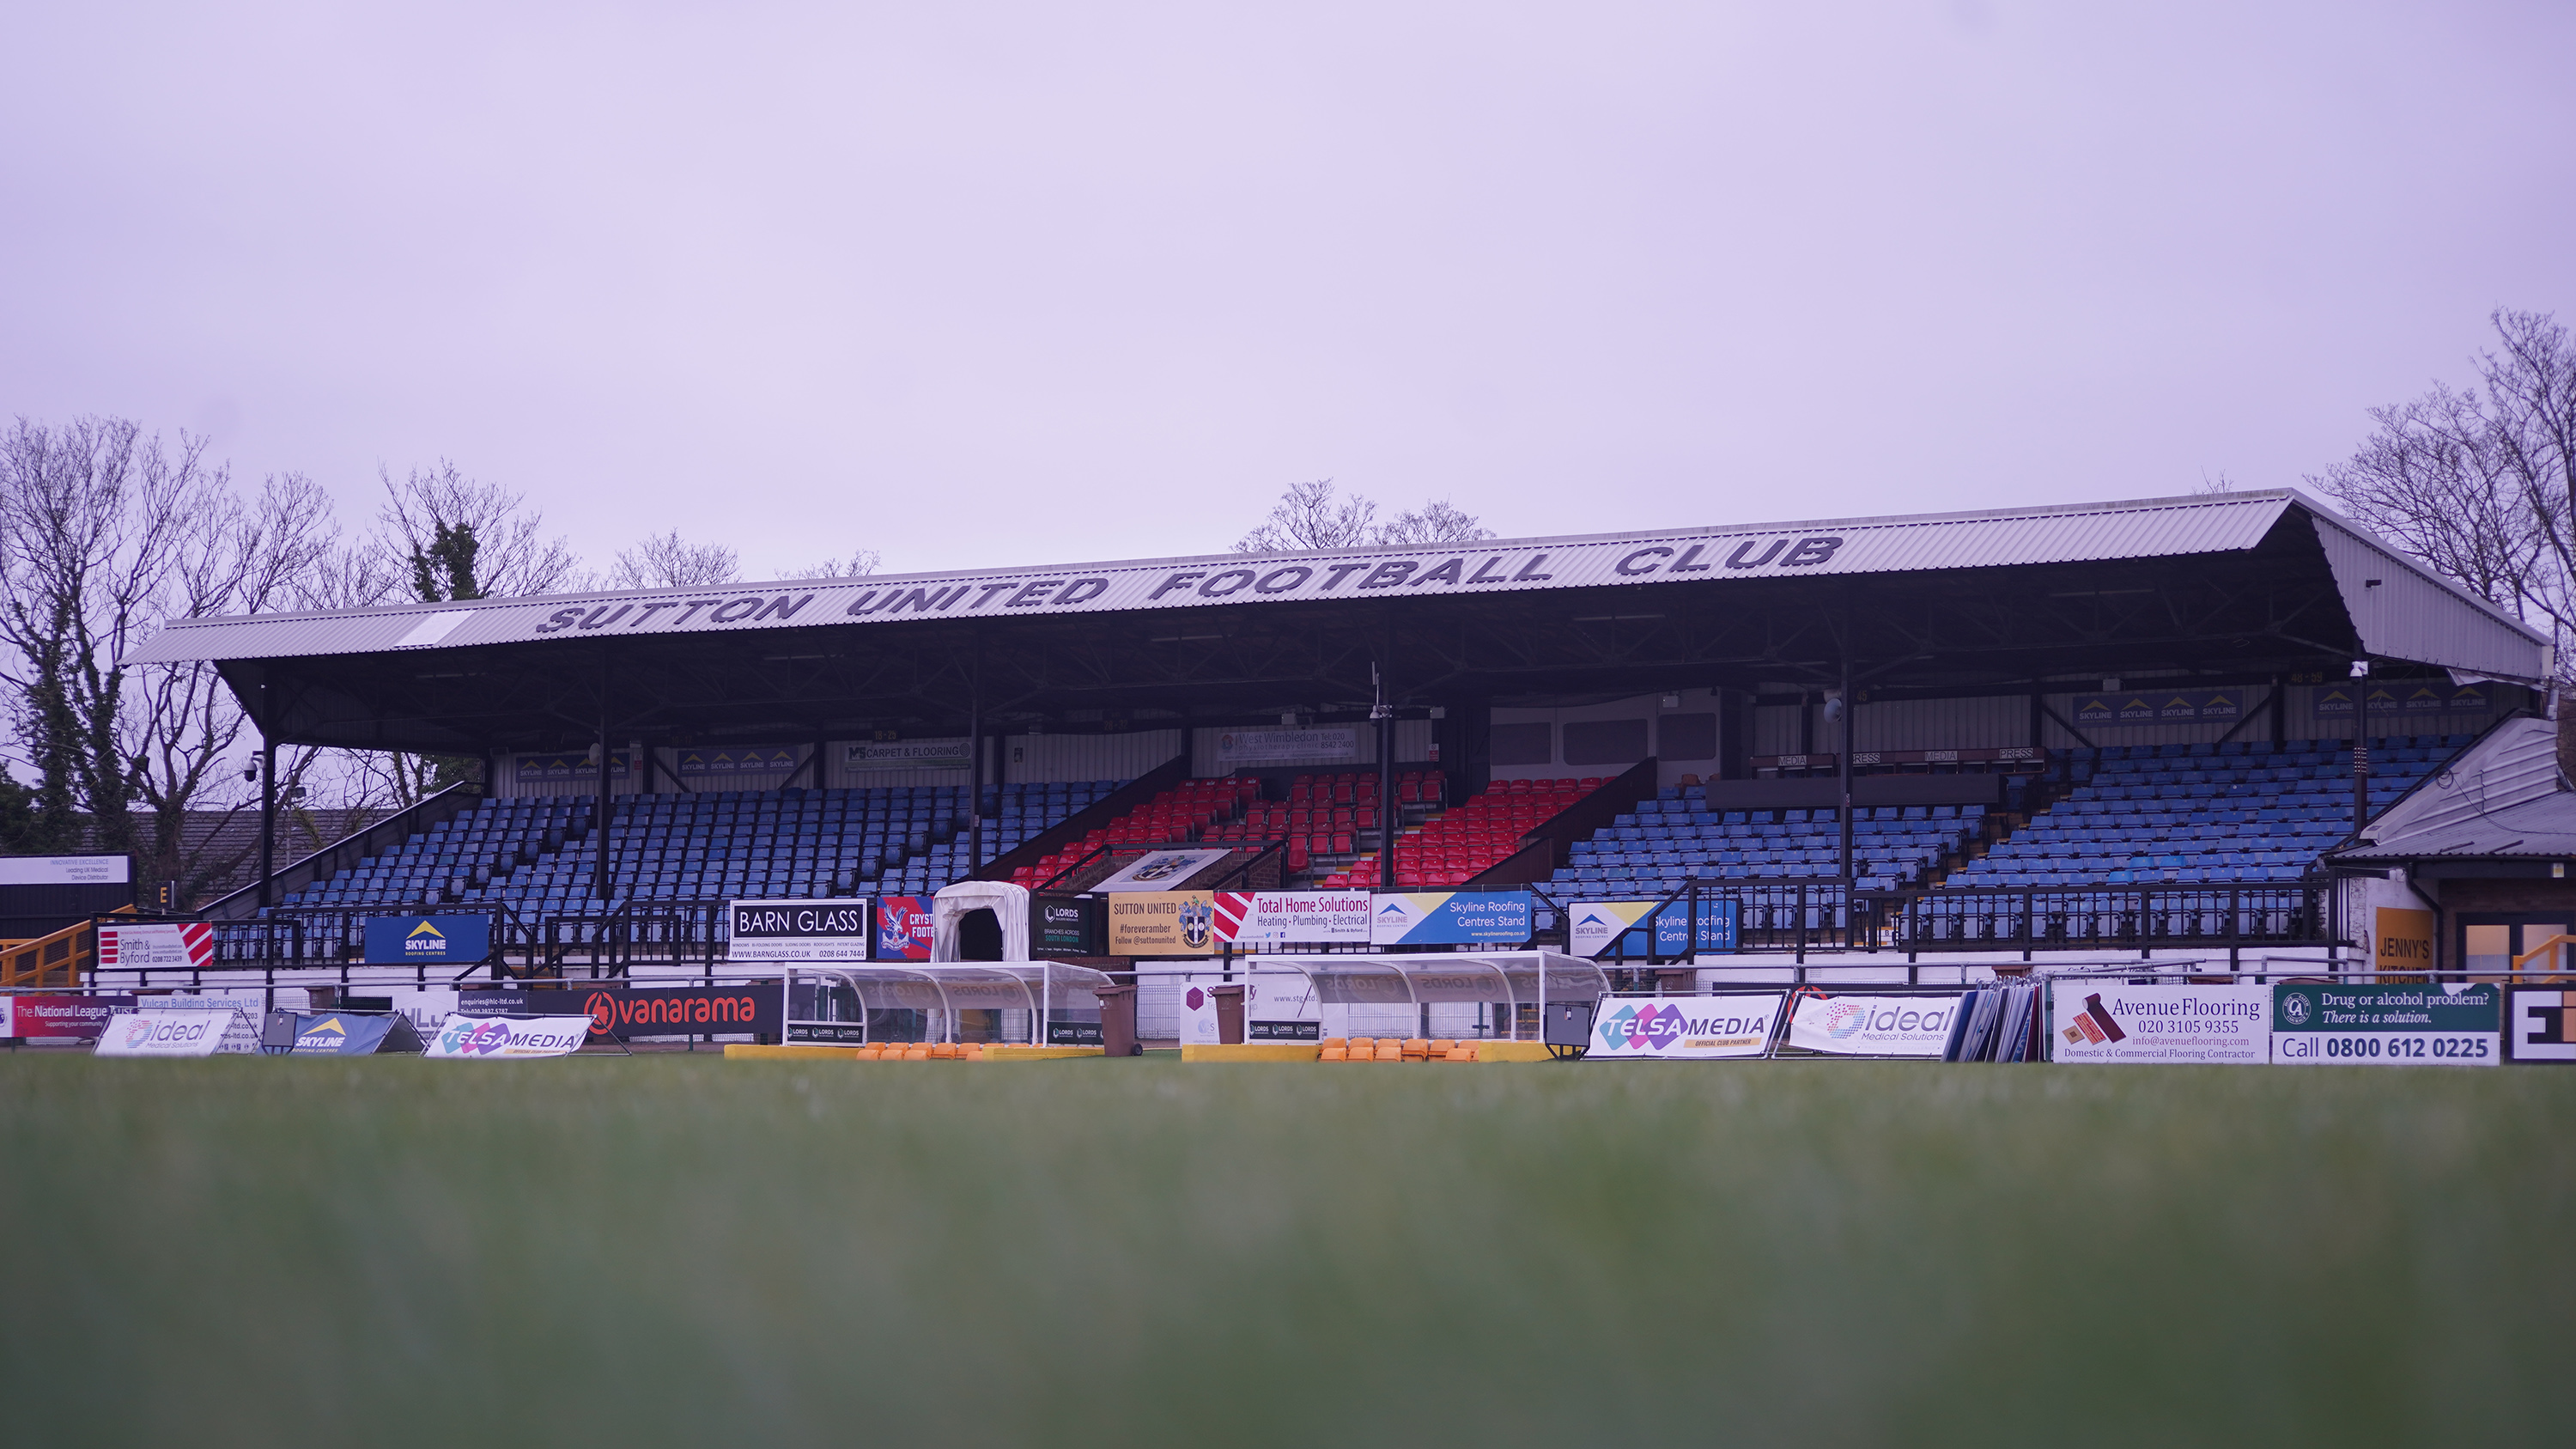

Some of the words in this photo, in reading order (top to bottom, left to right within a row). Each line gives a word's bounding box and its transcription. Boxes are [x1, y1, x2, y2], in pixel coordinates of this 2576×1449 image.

[535, 594, 814, 632] SUTTON
[846, 577, 1109, 616] UNITED
[1147, 554, 1570, 601] FOOTBALL
[1614, 535, 1844, 575] CLUB
[2161, 709, 2195, 717] SKYLINE
[2202, 707, 2237, 715] SKYLINE
[2319, 703, 2354, 711] SKYLINE
[2079, 711, 2112, 720] SKYLINE
[874, 731, 883, 740] 18
[1238, 734, 1262, 744] West
[1264, 732, 1318, 743] Wimbledon
[866, 748, 902, 758] CARPET
[903, 748, 910, 757] &
[913, 746, 959, 757] FLOORING
[1238, 743, 1295, 752] physiotherapy
[2000, 748, 2033, 758] PRESS
[1778, 756, 1807, 765] MEDIA
[1853, 753, 1880, 763] RESS
[1925, 752, 1957, 761] MEDIA
[160, 887, 167, 903] E
[1114, 904, 1145, 916] SUTTON
[1146, 903, 1176, 915] UNITED
[1257, 898, 1283, 914] Total
[1285, 897, 1316, 914] Home
[1318, 896, 1368, 913] Solutions
[1449, 902, 1485, 914] Skyline
[1487, 901, 1526, 914] Roofing
[1055, 908, 1078, 917] LORDS
[739, 911, 790, 933] BARN
[797, 910, 858, 932] GLASS
[910, 914, 933, 925] CRYST
[1257, 916, 1287, 928] Heating
[1292, 915, 1327, 928] Plumbing
[1333, 914, 1367, 925] Electrical
[1376, 916, 1408, 924] SKYLINE
[1457, 916, 1493, 927] Centres
[1495, 916, 1525, 927] Stand
[1120, 923, 1171, 935] #foreveramber
[1700, 929, 1730, 941] Stand
[120, 938, 143, 951] Smith
[144, 940, 150, 950] &
[405, 940, 447, 950] SKYLINE
[1115, 935, 1132, 945] Follow
[1133, 935, 1176, 946] @suttonunited
[2380, 937, 2429, 959] JENNY'S
[120, 951, 150, 966] Byford
[141, 998, 168, 1008] Vulcan
[171, 998, 204, 1008] Building
[206, 997, 242, 1008] Services
[244, 997, 258, 1008] Ltd
[460, 997, 524, 1007] enquiries@hlc-ltd.co.uk
[2322, 992, 2355, 1009] Drug
[2359, 995, 2374, 1006] or
[2376, 992, 2423, 1006] alcohol
[2427, 993, 2490, 1010] problem?
[15, 1006, 33, 1018] The
[34, 1004, 73, 1018] National
[75, 1004, 107, 1020] League
[618, 996, 756, 1025] vanarama
[2112, 998, 2179, 1016] Avenue
[2182, 998, 2261, 1021] Flooring
[1865, 1005, 1954, 1032] ideal
[2323, 1011, 2357, 1023] There
[2360, 1011, 2369, 1023] is
[2371, 1014, 2380, 1023] a
[2382, 1011, 2432, 1024] solution.
[79, 1020, 103, 1028] community
[1606, 1018, 1682, 1037] TELSA
[1687, 1017, 1765, 1036] MEDIA
[2138, 1020, 2164, 1033] 020
[2167, 1020, 2201, 1033] 3105
[2204, 1020, 2239, 1033] 9355
[151, 1020, 210, 1041] ideal
[1861, 1032, 1899, 1041] Medical
[1900, 1032, 1945, 1041] Solutions
[146, 1040, 170, 1049] Medical
[295, 1036, 346, 1047] SKYLINE
[446, 1030, 508, 1046] TELSA
[509, 1032, 574, 1048] MEDIA
[2132, 1036, 2250, 1047] info@avenueflooring.com
[2282, 1038, 2319, 1057] Call
[2327, 1038, 2380, 1058] 0800
[2388, 1038, 2426, 1058] 612
[2432, 1038, 2489, 1058] 0225
[2064, 1049, 2105, 1058] Domestic
[2105, 1049, 2113, 1058] &
[2115, 1049, 2167, 1058] Commercial
[2169, 1049, 2206, 1060] Flooring
[2207, 1049, 2256, 1059] Contractor
